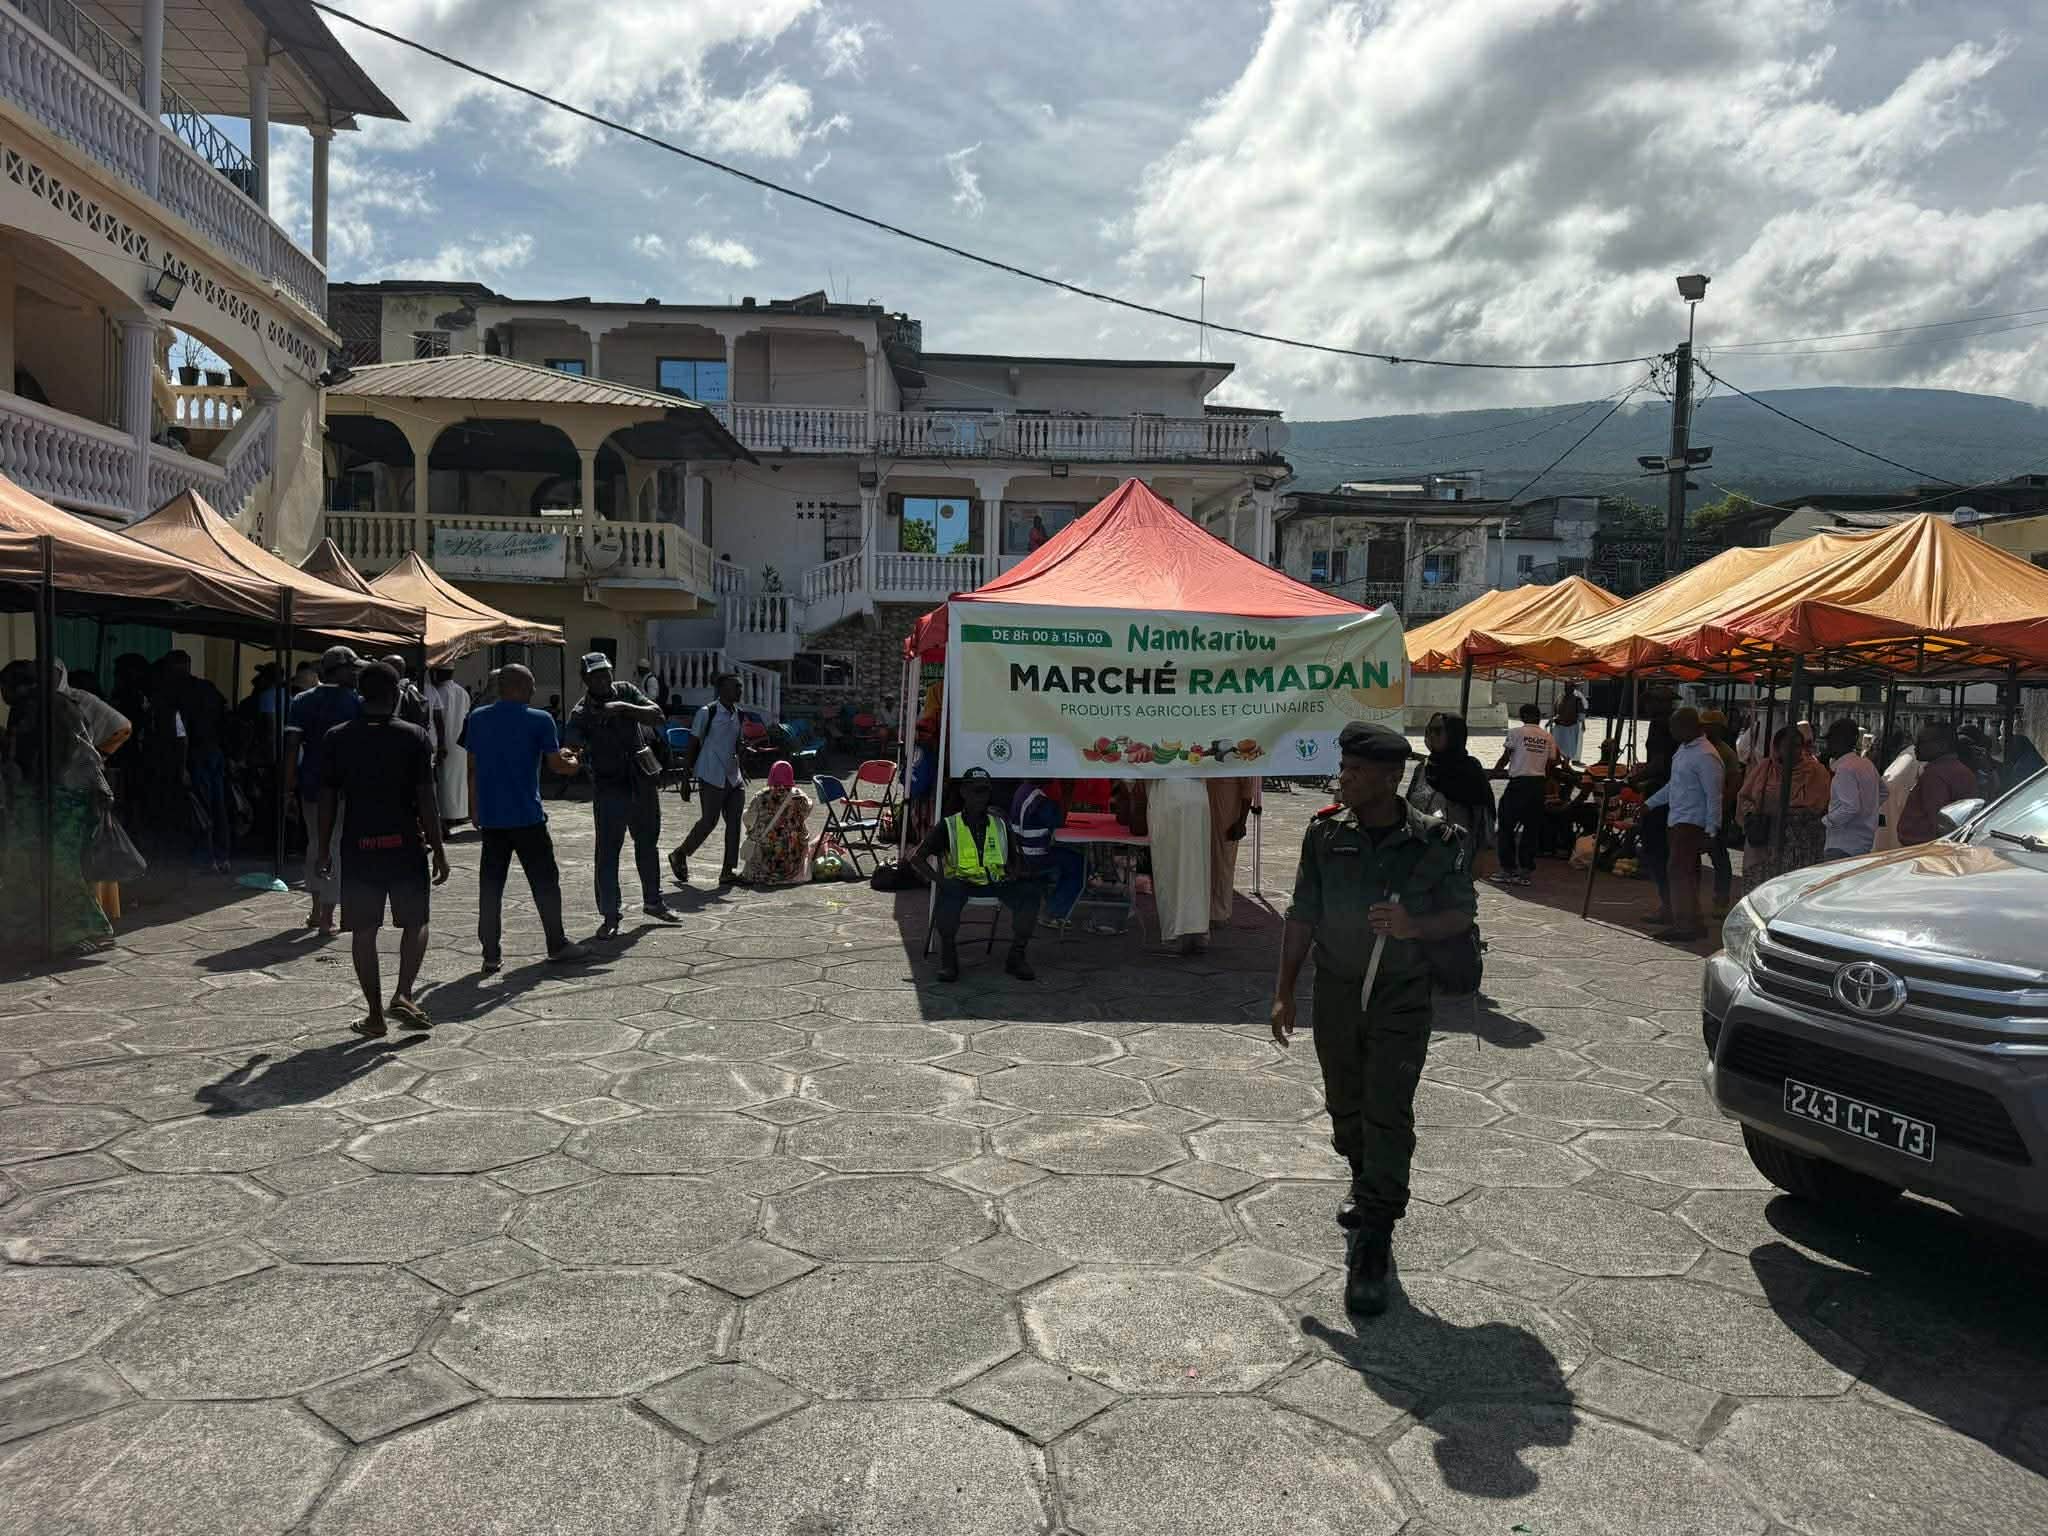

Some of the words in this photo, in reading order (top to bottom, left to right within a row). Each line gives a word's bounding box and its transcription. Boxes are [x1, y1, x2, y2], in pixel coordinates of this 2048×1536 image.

[991, 629, 1009, 641] DE
[1013, 629, 1029, 641] 8h
[1032, 630, 1049, 642] 00
[1051, 631, 1059, 642] à
[1062, 631, 1084, 643] 15h
[1087, 632, 1103, 644] 00
[1127, 623, 1276, 653] Namkaribu
[1010, 660, 1177, 695] MARCHÉ
[1188, 661, 1389, 695] RAMADAN
[1060, 703, 1131, 717] PRODUITS
[1135, 704, 1217, 717] AGRICOLES
[1221, 704, 1238, 716] ET
[1241, 700, 1325, 716] CULINAIRES
[1791, 1084, 1838, 1124] 243
[1847, 1103, 1880, 1139] CC
[1892, 1115, 1925, 1154] 73
